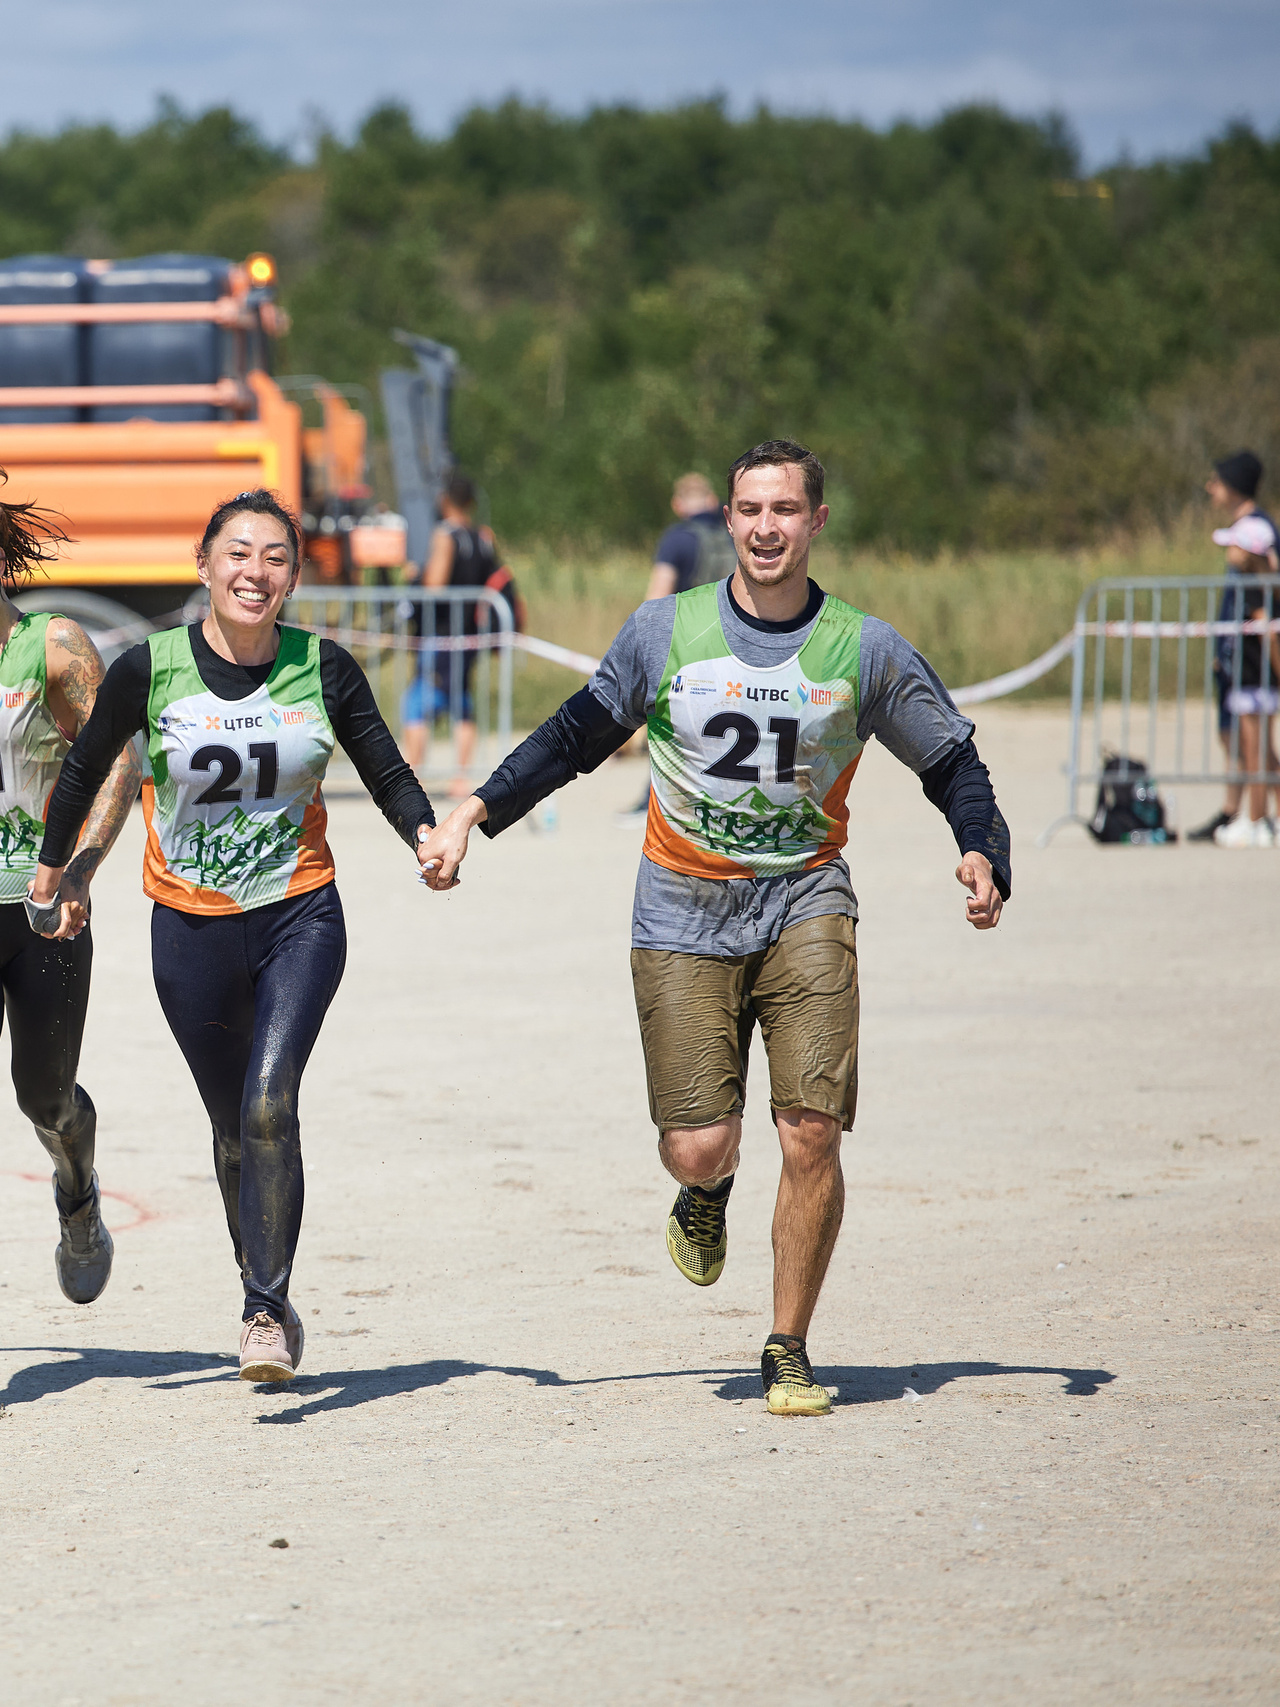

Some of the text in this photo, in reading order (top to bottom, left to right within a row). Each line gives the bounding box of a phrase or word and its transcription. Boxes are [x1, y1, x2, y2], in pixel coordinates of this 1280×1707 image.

[5, 691, 24, 709] ЦСП
[747, 687, 789, 702] ЦТВС
[811, 688, 831, 706] ЦСП
[224, 716, 263, 731] ЦТВС
[283, 711, 305, 726] ЦСП
[700, 710, 801, 784] 21
[188, 740, 279, 806] 21
